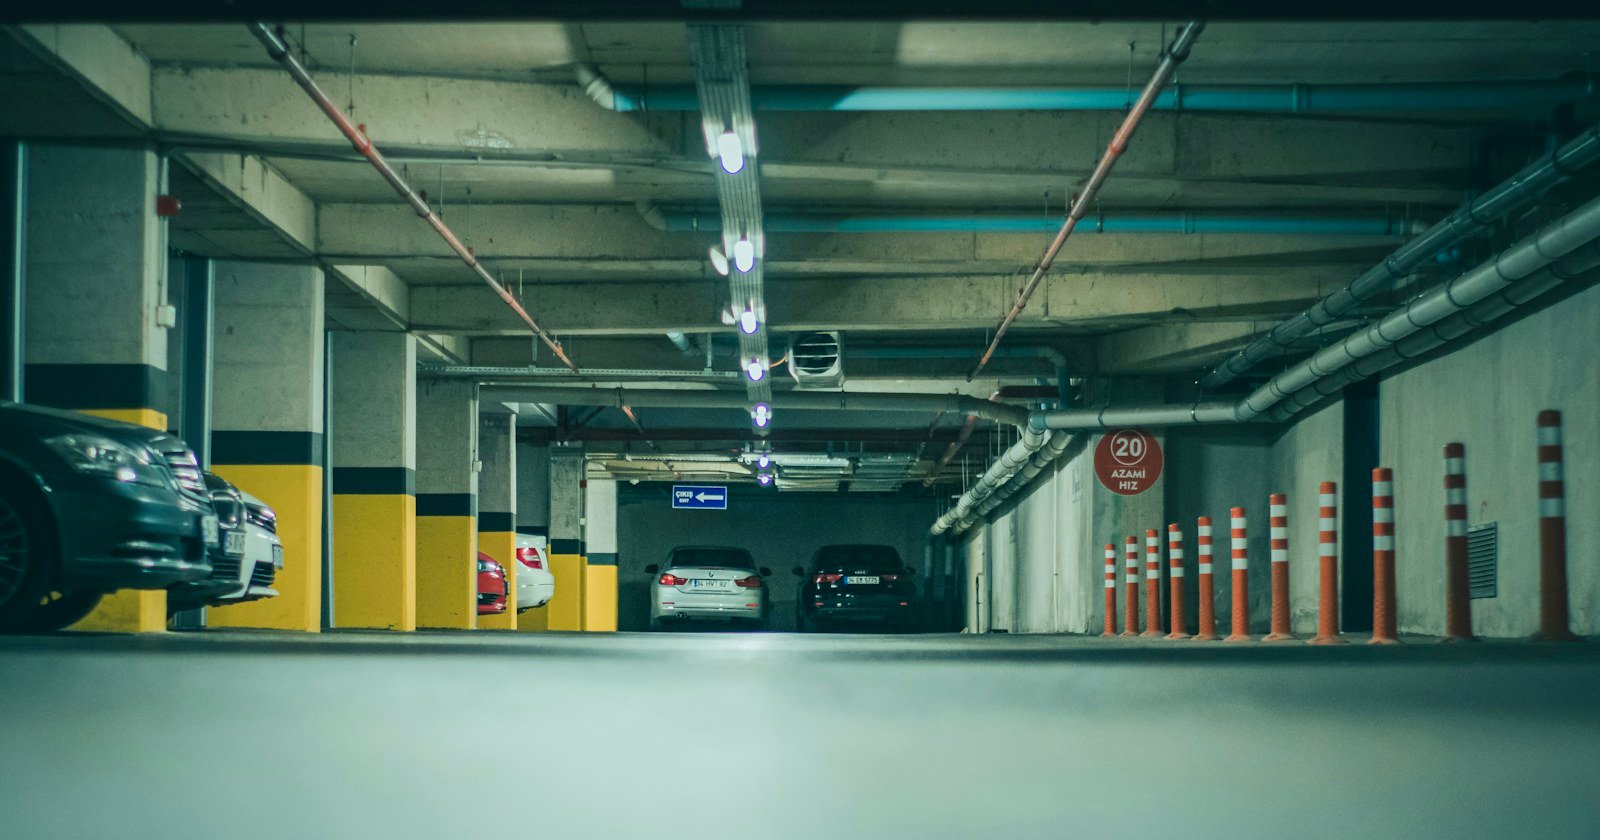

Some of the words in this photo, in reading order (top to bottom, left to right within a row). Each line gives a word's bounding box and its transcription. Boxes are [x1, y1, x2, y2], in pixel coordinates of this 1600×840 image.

[1115, 437, 1142, 457] 20
[1111, 467, 1146, 478] AZAMİ
[1119, 481, 1138, 490] HIZ
